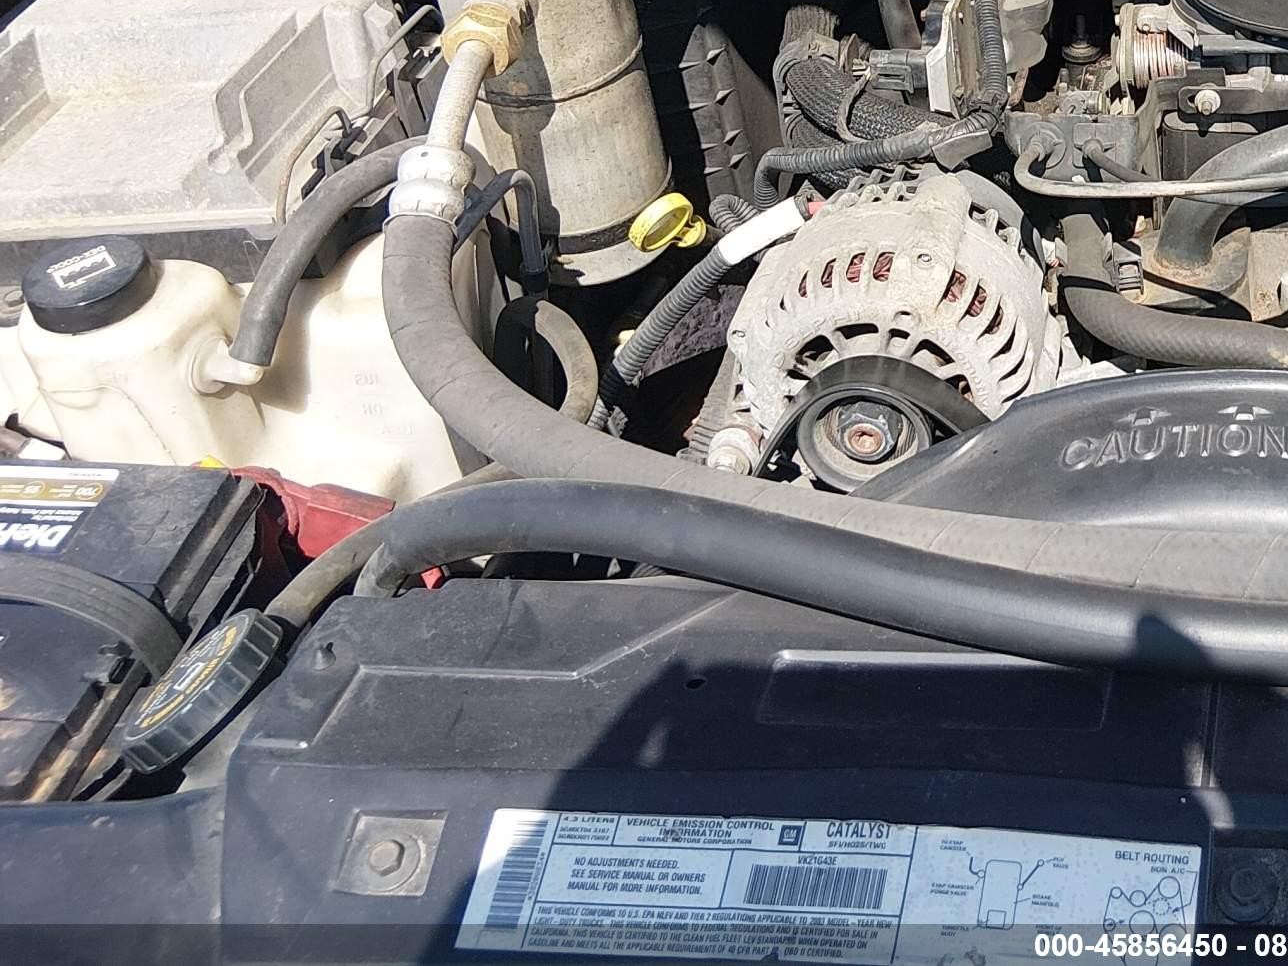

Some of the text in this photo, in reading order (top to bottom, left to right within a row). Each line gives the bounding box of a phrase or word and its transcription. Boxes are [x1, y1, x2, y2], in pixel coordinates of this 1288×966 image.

[627, 818, 775, 830] VEHICLE EMISSION CONTROL
[826, 822, 891, 839] CATALYST
[574, 857, 680, 869] NO ADJUSTMENTS NEEDED.
[1115, 850, 1189, 865] BELT ROUTING
[571, 869, 706, 882] SEE SERVICE MANUAL OR OWNERS
[567, 881, 703, 895] MANUAL FOR MORE INFORMATION.
[538, 906, 551, 914] THIS
[554, 907, 579, 915] VEHICLE
[642, 910, 655, 919] EPA
[674, 911, 688, 920] AND
[758, 915, 797, 924] APPLICABLE
[589, 929, 615, 939] VEHICLE
[625, 931, 657, 941] CERTIFIED
[669, 933, 682, 941] THE
[700, 923, 727, 932] FEDERAL
[776, 925, 790, 934] AND
[800, 927, 835, 937] CERTIFIED
[836, 929, 850, 937] FOR
[851, 929, 868, 938] SALE
[870, 931, 878, 939] IN
[561, 939, 575, 948] AND
[599, 941, 611, 950] ALL
[613, 941, 625, 950] THE
[626, 942, 665, 952] APPLICABLE
[667, 944, 717, 954] REQUIREMENTS
[752, 946, 770, 955] PART
